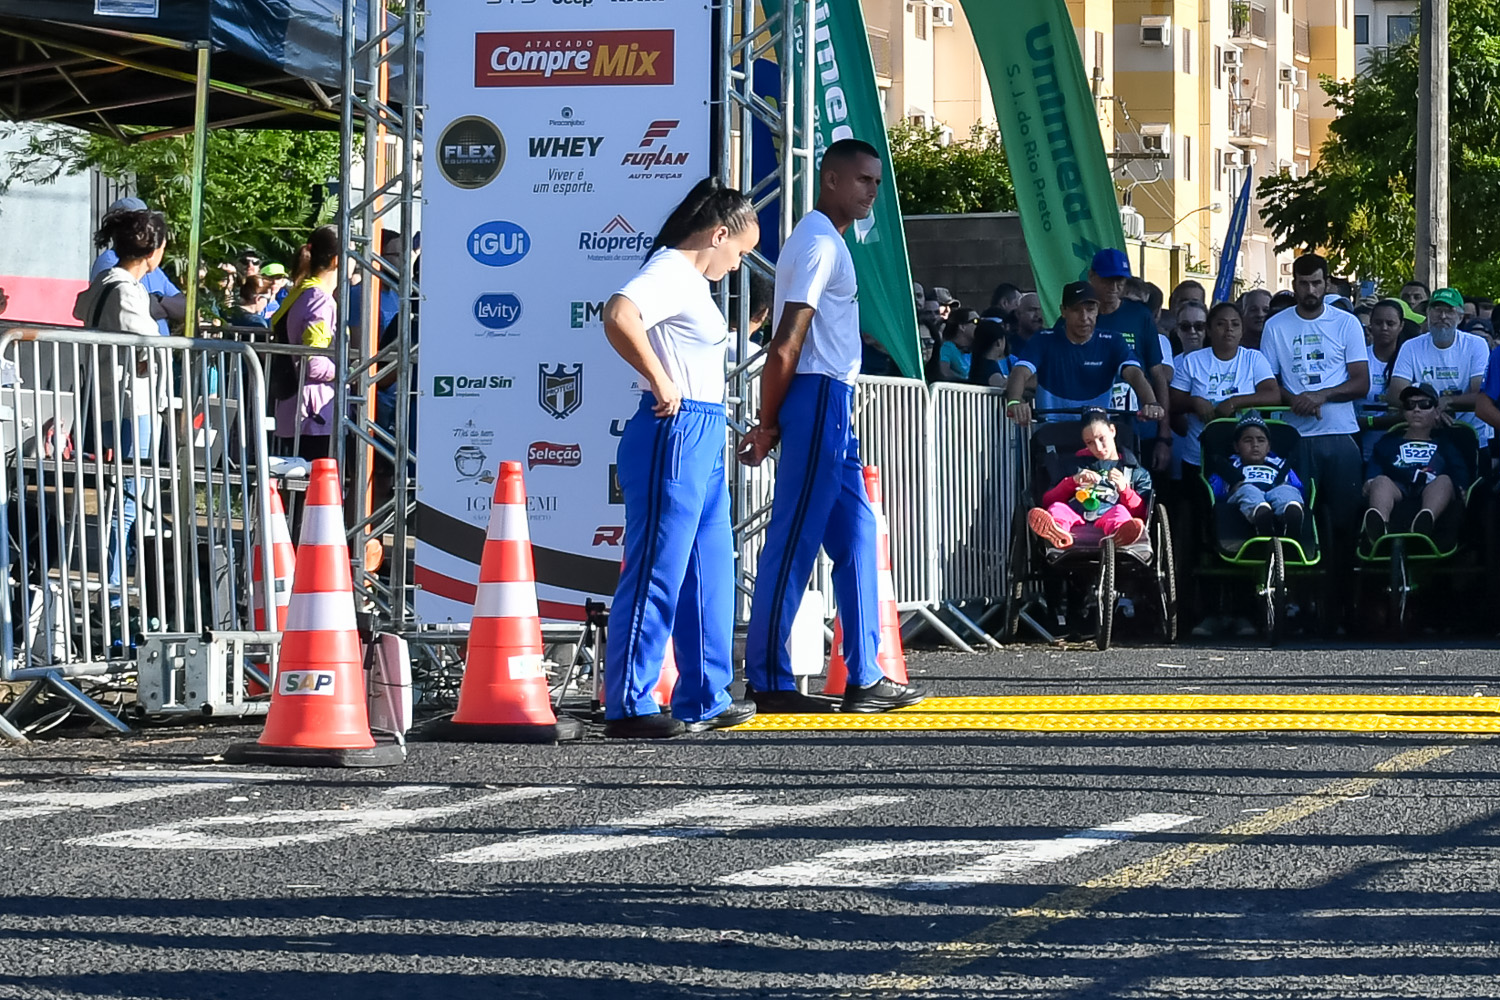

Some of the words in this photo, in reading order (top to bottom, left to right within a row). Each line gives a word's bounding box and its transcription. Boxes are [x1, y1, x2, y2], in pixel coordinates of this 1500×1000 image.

[525, 40, 594, 48] ATACADO
[490, 46, 591, 77] Compre
[592, 43, 660, 77] Mix
[1017, 111, 1032, 136] do
[1025, 22, 1092, 225] Unimed
[444, 145, 496, 158] FLEX
[528, 137, 605, 157] WHEY
[1023, 140, 1040, 173] Rio
[621, 145, 690, 170] FURLAN
[548, 168, 574, 181] Viver
[577, 168, 584, 181] é
[533, 183, 549, 193] um
[553, 181, 595, 196] esporte.
[1032, 177, 1053, 233] Preto
[579, 231, 655, 253] Rioprefe
[456, 376, 487, 389] Oral
[489, 376, 512, 389] Sin
[528, 447, 580, 463] Seleção
[285, 674, 333, 692] SAP
